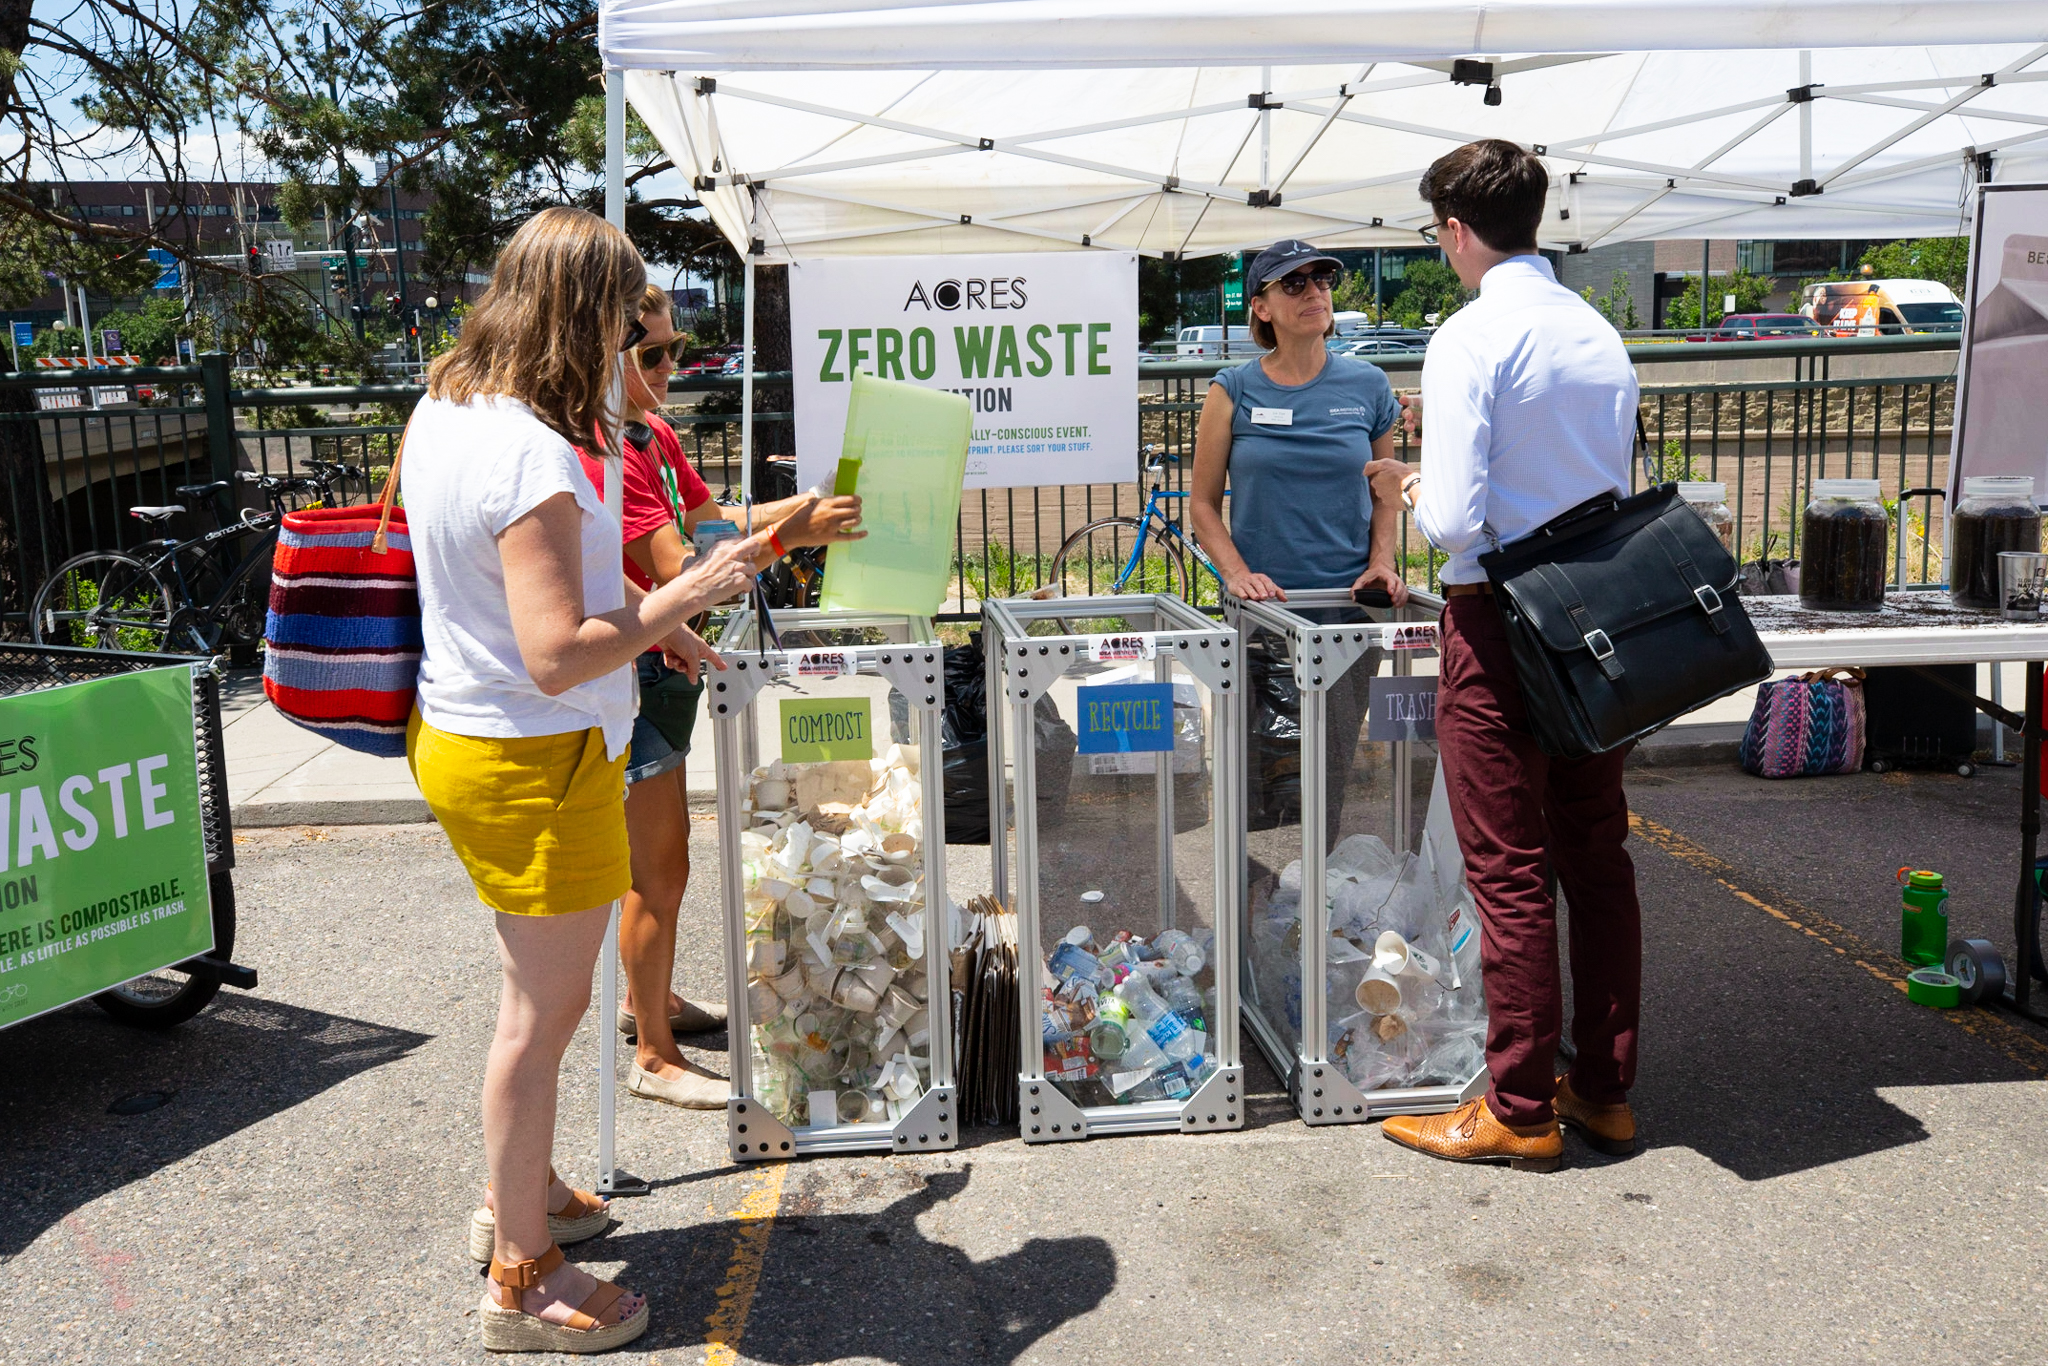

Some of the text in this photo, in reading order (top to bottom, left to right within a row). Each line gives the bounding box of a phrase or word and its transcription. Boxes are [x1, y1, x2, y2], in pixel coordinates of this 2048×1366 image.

[2027, 250, 2048, 265] BE
[903, 276, 1028, 312] ACRES
[818, 322, 1112, 383] ZERO WASTE
[968, 445, 996, 455] TPRINT.
[997, 444, 1025, 454] PLEASE
[1026, 443, 1045, 453] SORT
[1047, 443, 1066, 452] YOUR
[1068, 442, 1093, 452] STUFF.
[970, 425, 1092, 441] ALLY-CONSCIOUS EVENT.
[1100, 636, 1144, 649] ACRES
[1394, 626, 1436, 638] ACRES
[800, 652, 845, 664] ACRES
[1088, 700, 1162, 732] RECYCLE
[1385, 691, 1439, 721] TRASH
[789, 711, 863, 744] COMPOST
[0, 753, 175, 873] ASTE
[0, 877, 186, 956] ERE IS COMPOSTABLE.
[20, 950, 35, 967] AS
[37, 937, 73, 962] LITTLE
[75, 932, 89, 949] AS
[91, 914, 139, 943] POSSIBLE
[140, 911, 151, 926] IS
[152, 900, 187, 921] TRASH.
